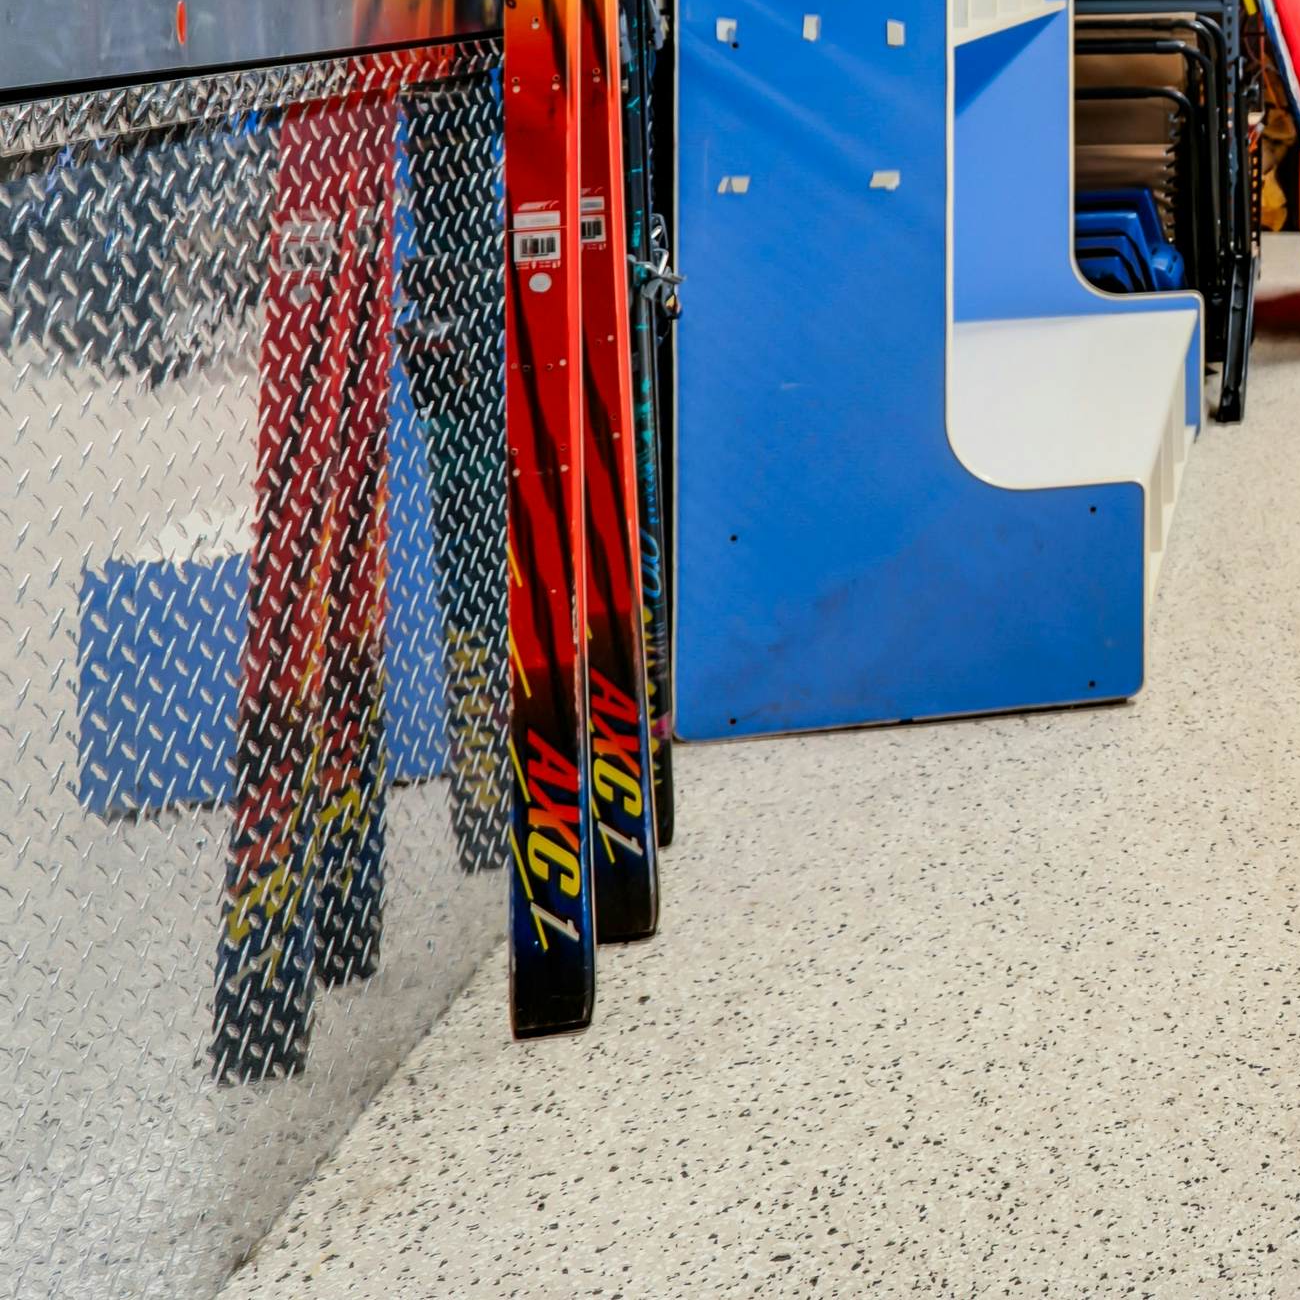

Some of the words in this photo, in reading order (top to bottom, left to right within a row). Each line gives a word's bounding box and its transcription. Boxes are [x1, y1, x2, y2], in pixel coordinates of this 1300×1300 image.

[588, 667, 643, 817] AXC
[526, 727, 581, 897] AXC
[597, 819, 644, 856] 1
[529, 901, 580, 942] 1
